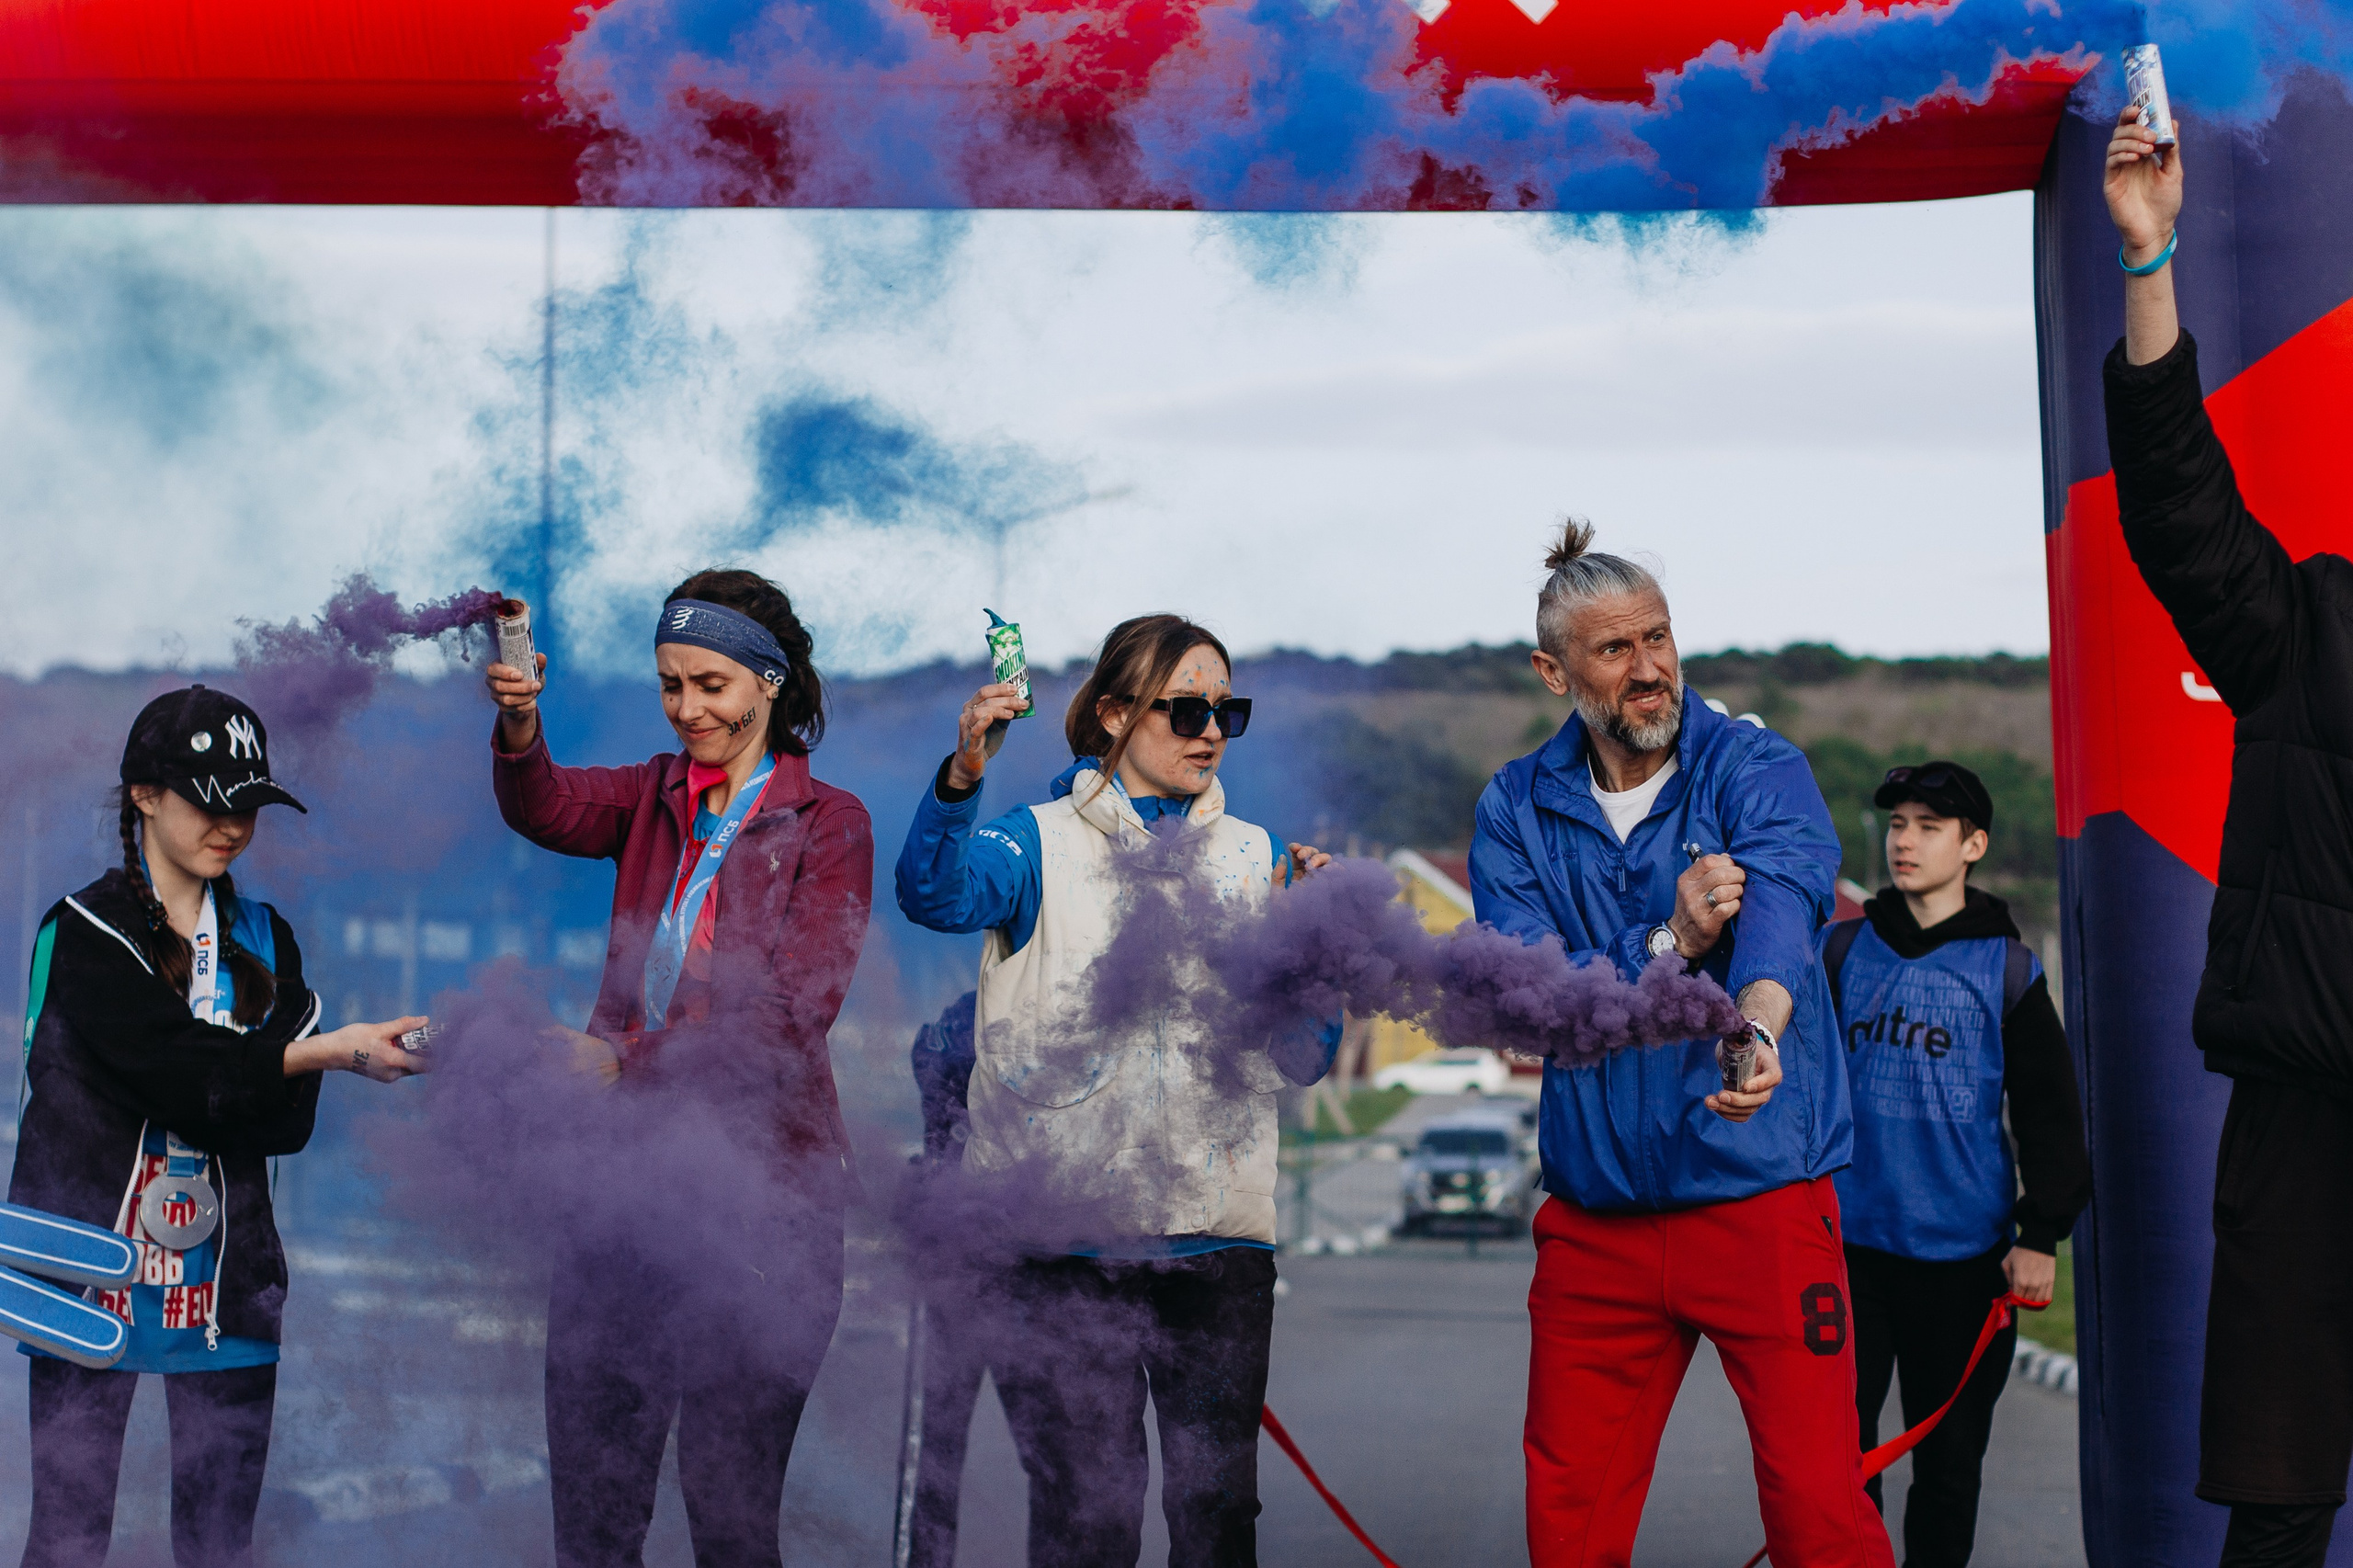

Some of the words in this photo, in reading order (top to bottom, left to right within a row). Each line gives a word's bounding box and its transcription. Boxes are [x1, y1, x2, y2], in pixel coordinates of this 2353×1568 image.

[765, 669, 784, 687] CO
[716, 820, 739, 842] ПСБ
[197, 949, 209, 976] ПСБ
[1799, 1282, 1847, 1357] 8
